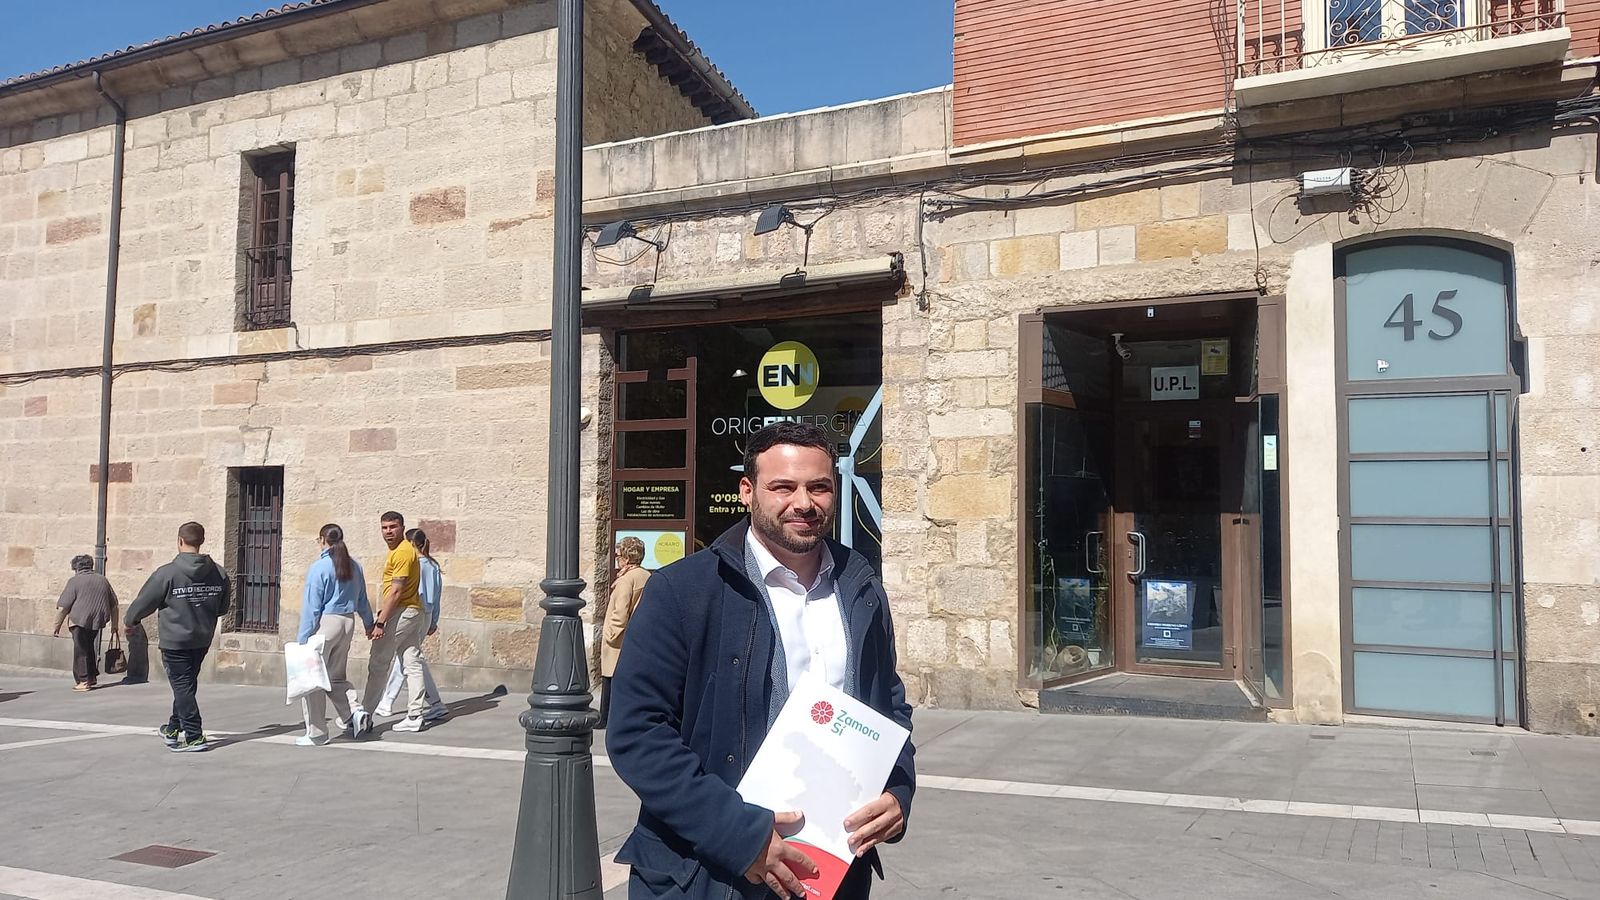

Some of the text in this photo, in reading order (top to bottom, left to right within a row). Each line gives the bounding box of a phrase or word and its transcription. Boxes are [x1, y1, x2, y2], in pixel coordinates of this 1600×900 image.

[1383, 289, 1463, 342] 45
[1153, 376, 1197, 392] U.P.L.
[831, 722, 847, 737] Sí
[837, 709, 880, 741] Zamora
